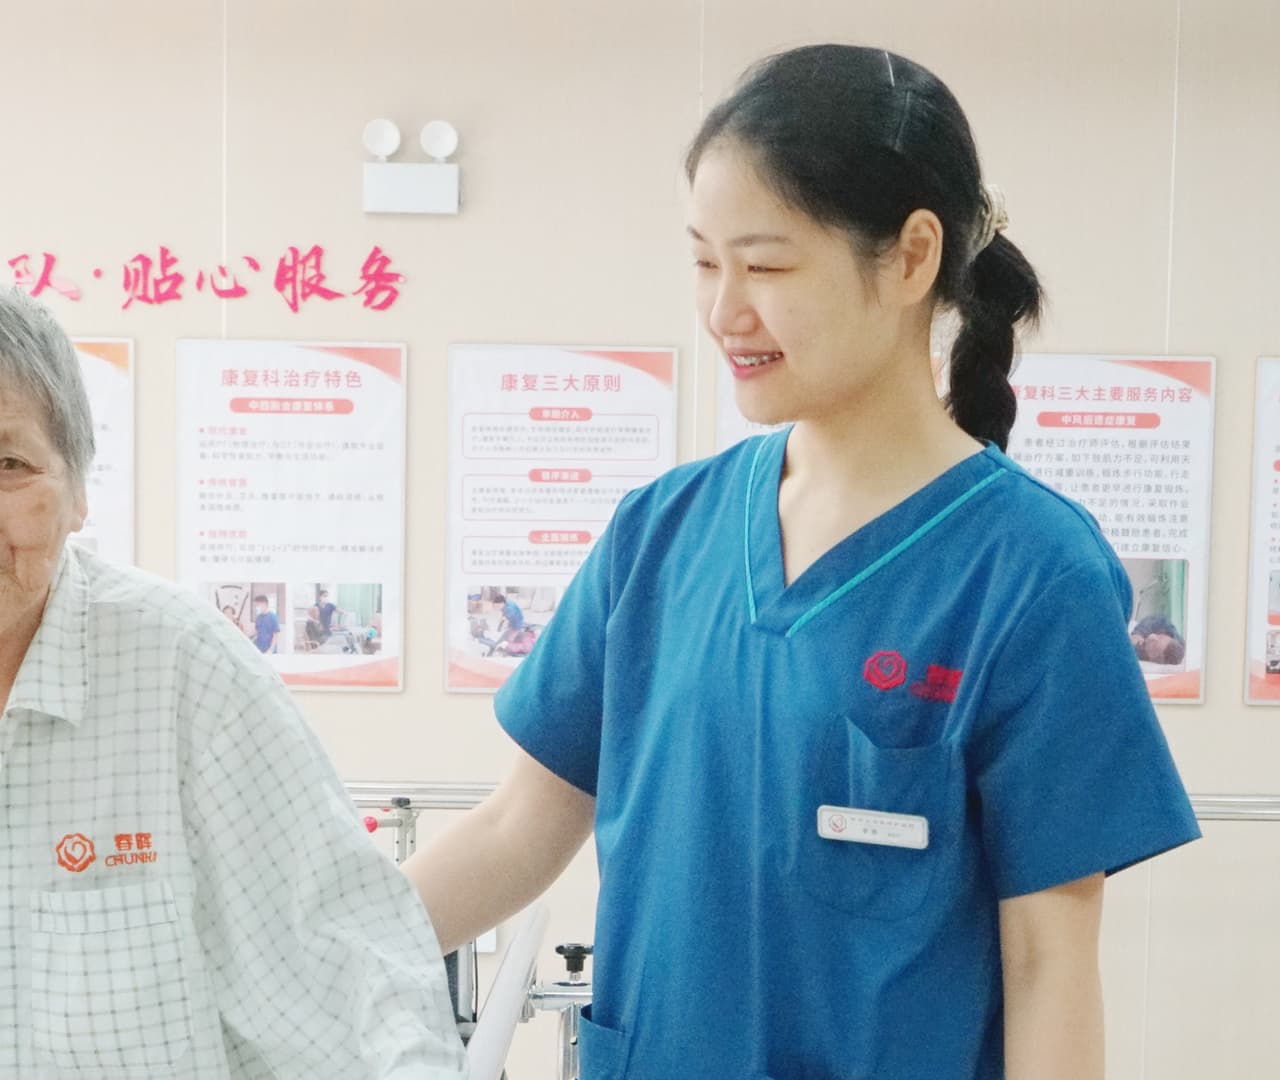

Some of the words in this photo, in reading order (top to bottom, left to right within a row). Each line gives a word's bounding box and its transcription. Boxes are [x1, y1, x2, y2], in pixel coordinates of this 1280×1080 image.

[221, 369, 363, 388] 康复科治疗特色
[500, 374, 622, 393] 康复三大原则
